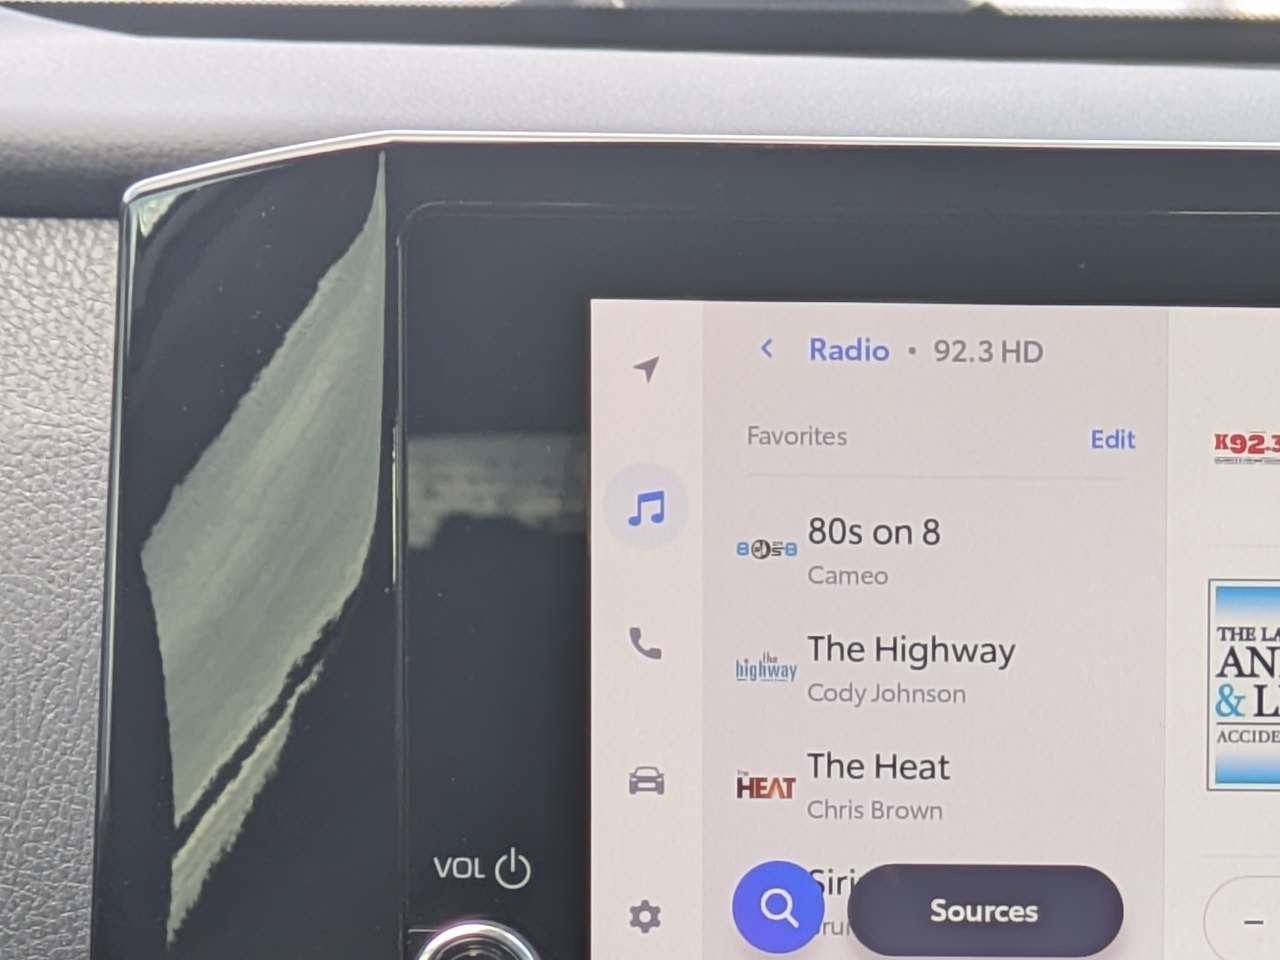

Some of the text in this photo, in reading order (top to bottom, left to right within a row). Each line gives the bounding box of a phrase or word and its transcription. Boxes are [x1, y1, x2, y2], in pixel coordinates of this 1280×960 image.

[809, 337, 1044, 364] Radio 92.3 HD
[747, 425, 848, 447] Favorites
[1090, 429, 1137, 451] Edit
[807, 516, 941, 547] 80s on 8
[807, 565, 889, 587] Cameo
[1216, 626, 1256, 642] THE
[807, 635, 1017, 671] The Highway
[736, 658, 798, 682] highway
[807, 683, 967, 709] Cody Johnson
[1215, 683, 1247, 718] &
[807, 752, 951, 781] The Heat
[736, 777, 797, 799] HEAT
[807, 799, 944, 822] Chris Brown
[432, 856, 486, 879] VOL
[930, 898, 1039, 924] Sources
